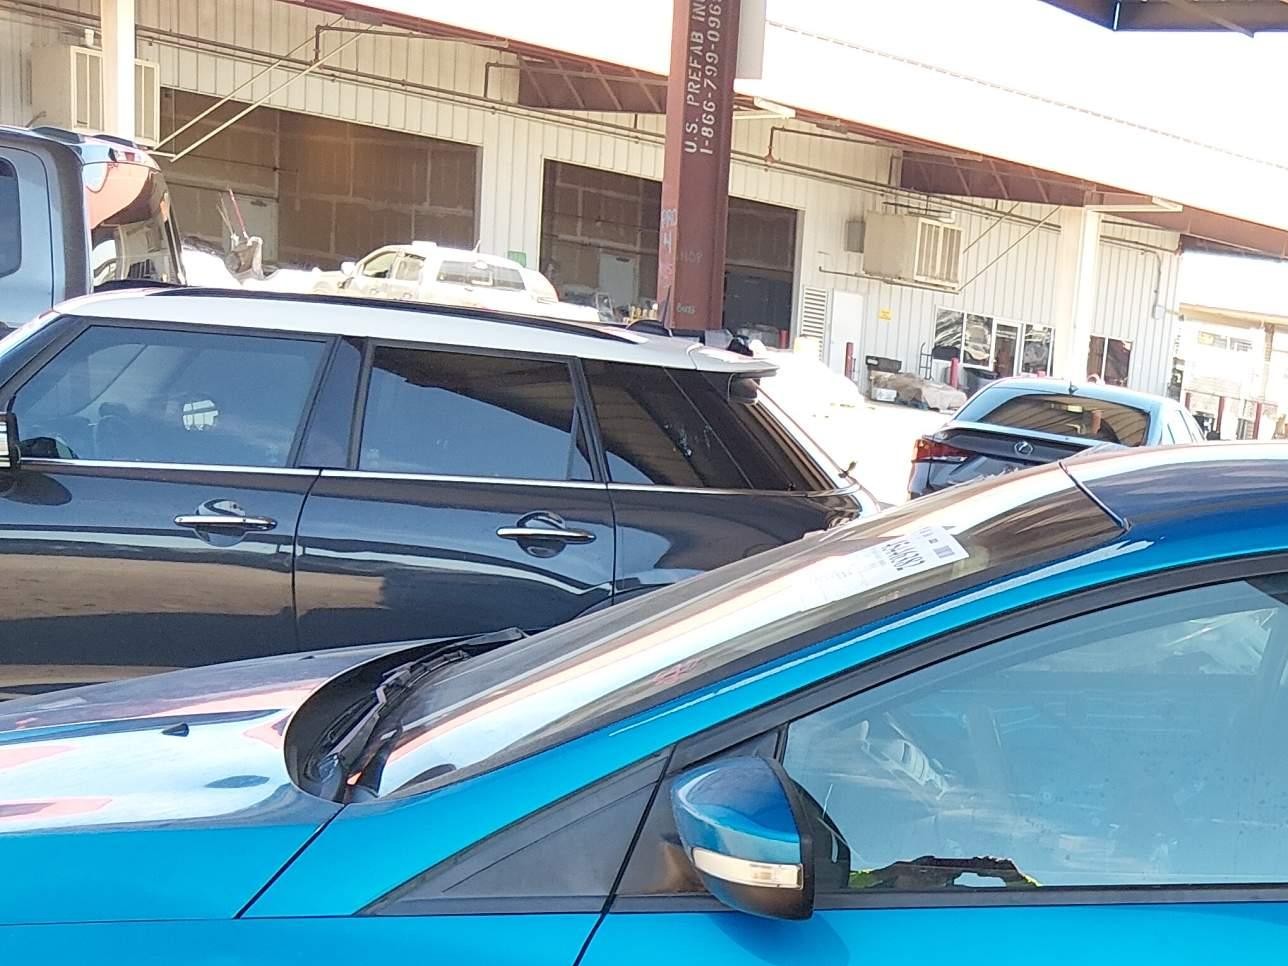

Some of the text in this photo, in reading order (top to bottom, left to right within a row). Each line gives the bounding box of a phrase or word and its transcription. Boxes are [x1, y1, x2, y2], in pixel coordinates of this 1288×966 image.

[684, 0, 706, 153] U.S. PREFAB IN
[700, 0, 723, 155] 1-866-799-096
